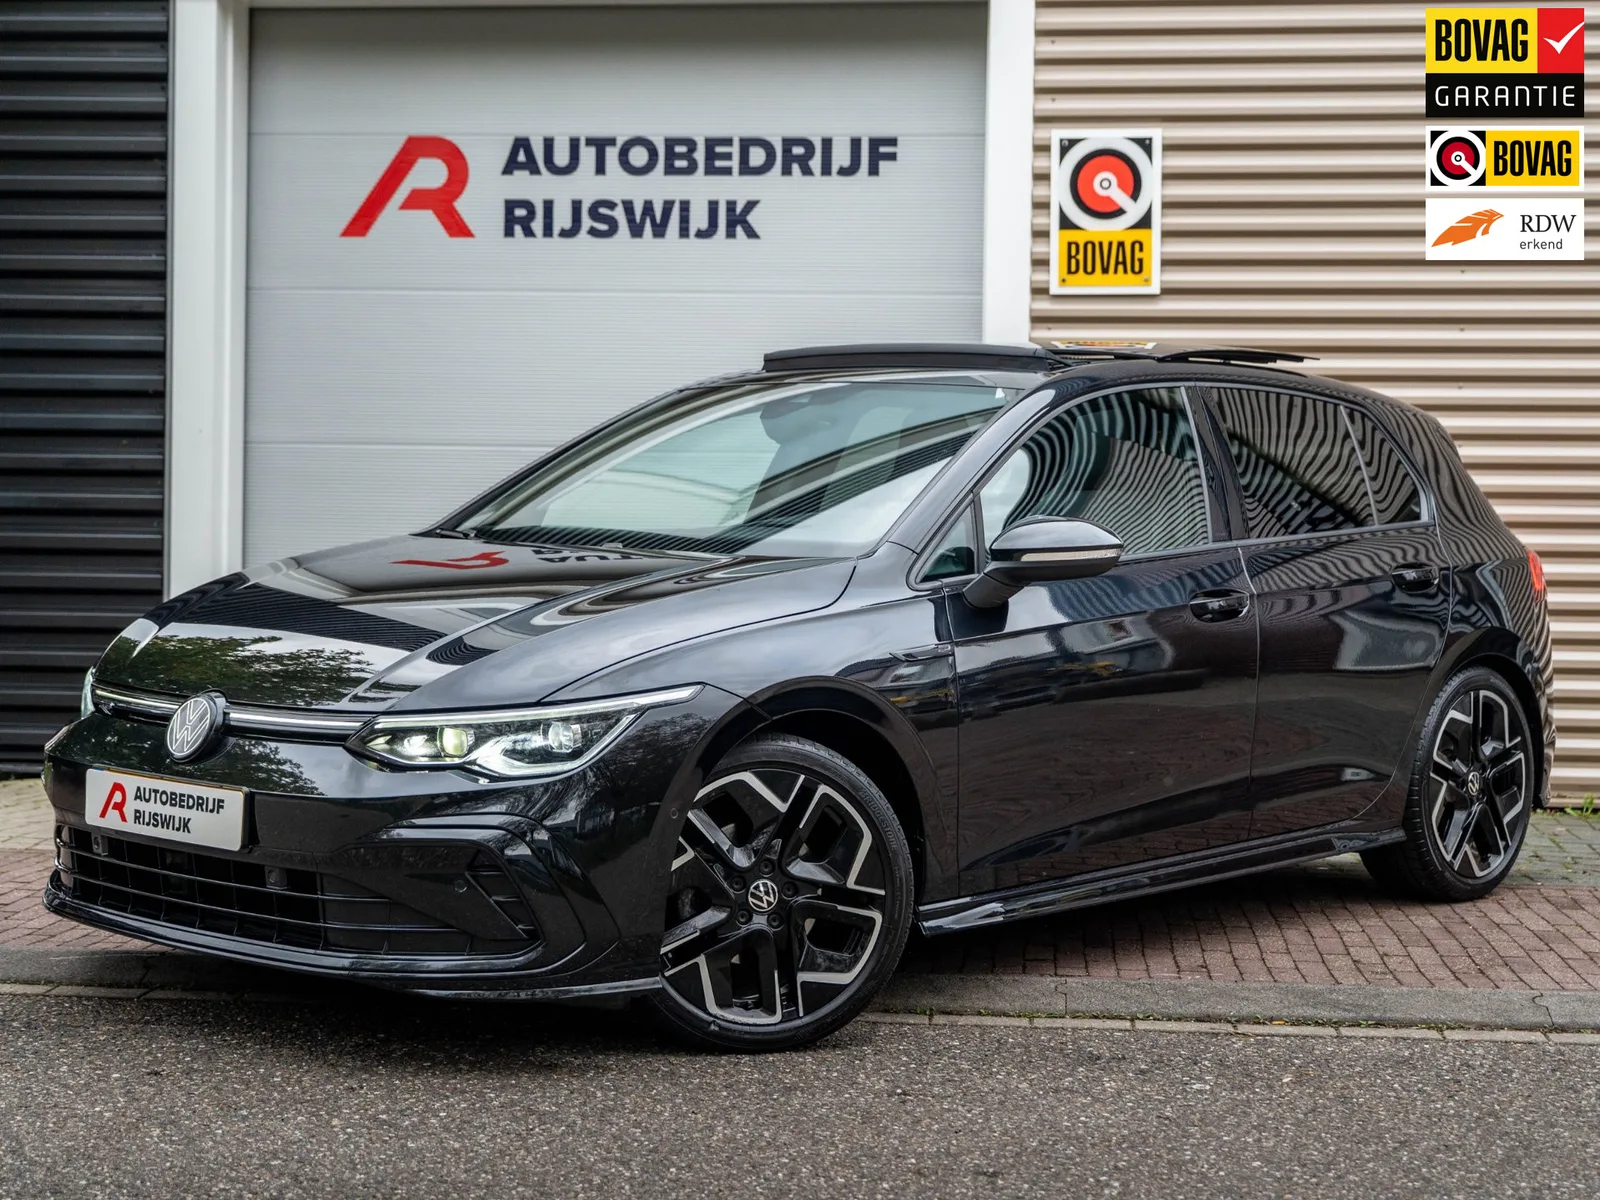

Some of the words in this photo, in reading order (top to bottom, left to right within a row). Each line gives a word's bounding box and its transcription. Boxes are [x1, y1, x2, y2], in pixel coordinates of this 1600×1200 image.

[501, 136, 898, 177] AUTOBEDRIJF
[503, 199, 761, 239] RIJSWIJK
[1066, 240, 1144, 275] BOVAG
[133, 785, 225, 815] AUTOBEDRIJF
[133, 809, 191, 834] RIJSWIJK
